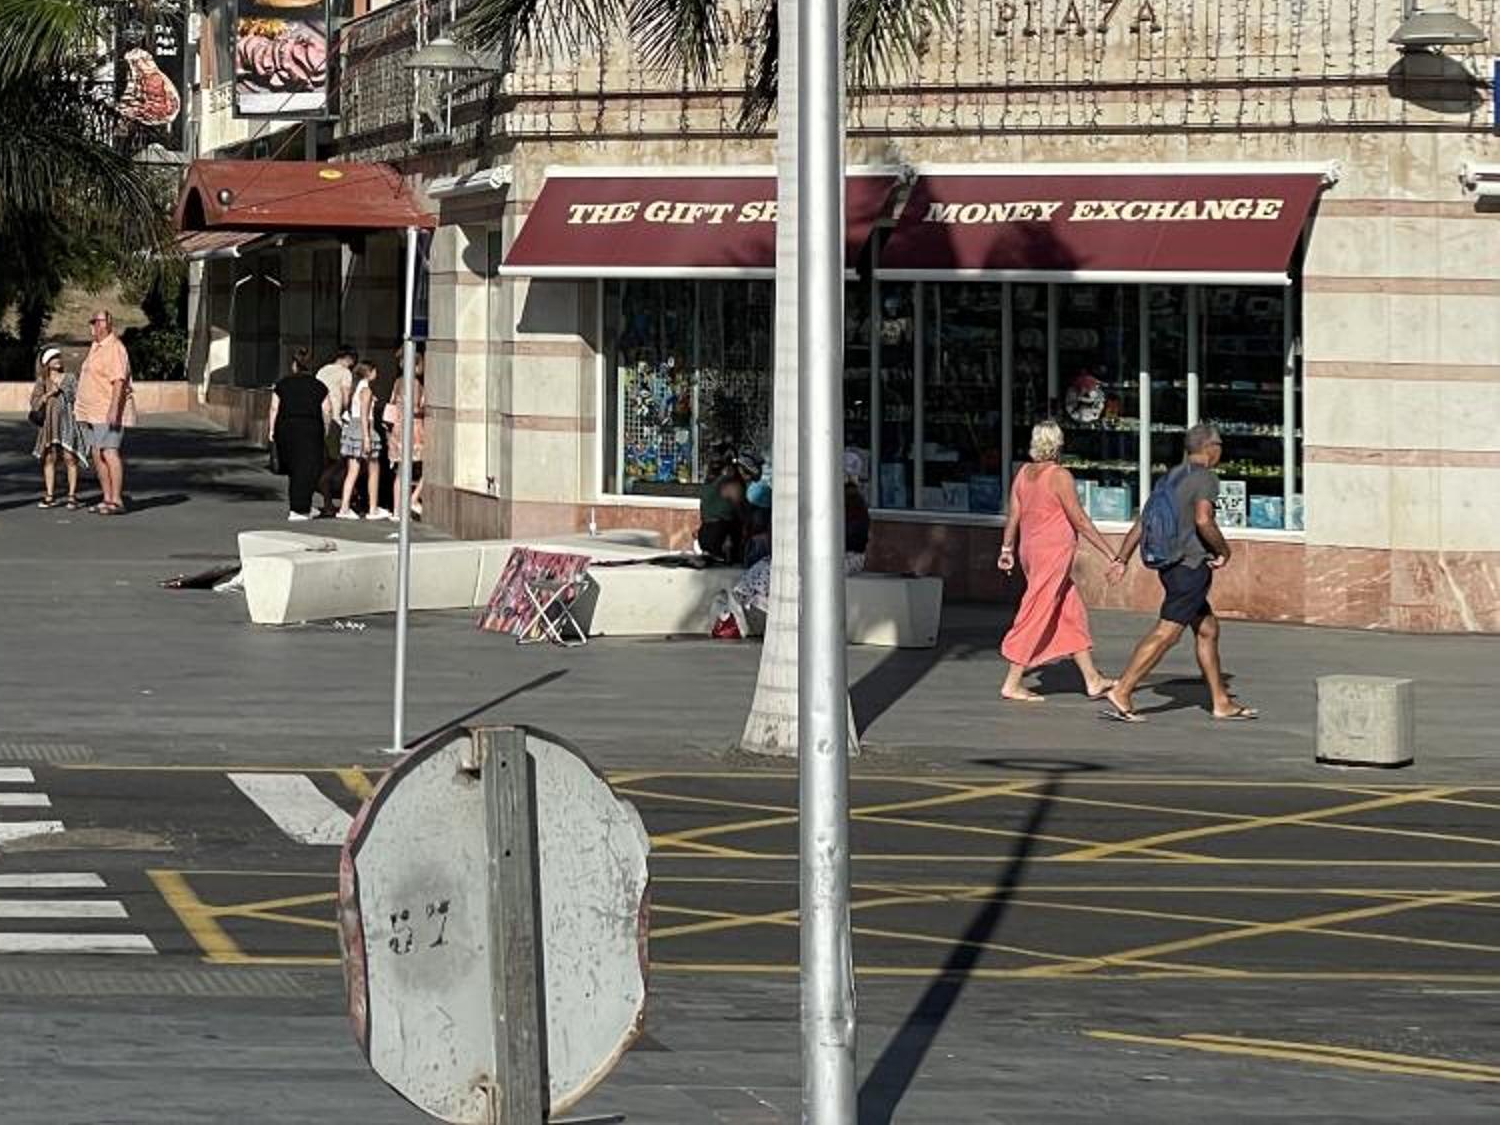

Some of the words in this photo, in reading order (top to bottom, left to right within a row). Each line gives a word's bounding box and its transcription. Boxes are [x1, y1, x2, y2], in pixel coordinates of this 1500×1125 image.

[567, 202, 640, 224] THE
[643, 201, 734, 223] GIFT
[737, 200, 778, 222] SH
[924, 201, 1064, 224] MONEY
[1068, 198, 1285, 221] EXCHANGE
